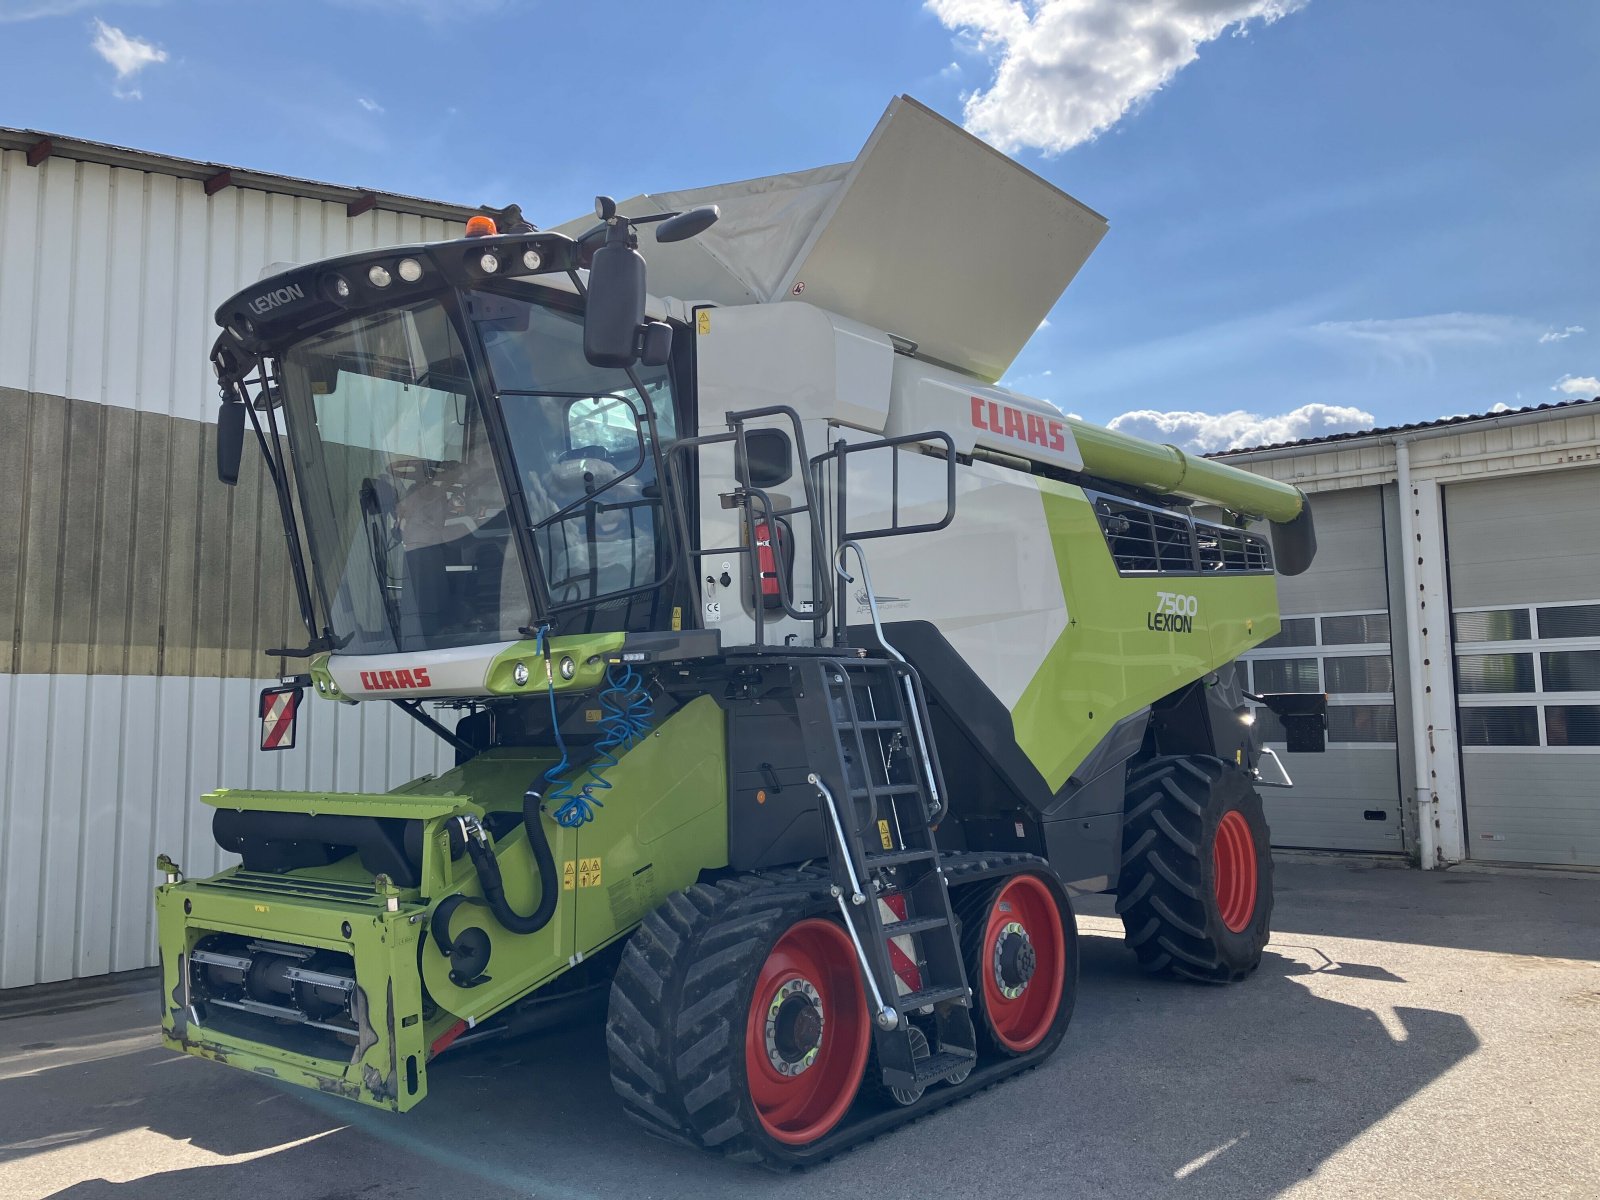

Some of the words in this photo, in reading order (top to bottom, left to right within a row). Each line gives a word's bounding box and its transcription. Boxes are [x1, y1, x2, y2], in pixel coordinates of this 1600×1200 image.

[248, 283, 305, 315] LEXION
[970, 396, 1065, 453] CLAAS
[1156, 591, 1198, 617] 7500
[1147, 611, 1193, 634] LEXION
[360, 667, 431, 690] CLAAS
